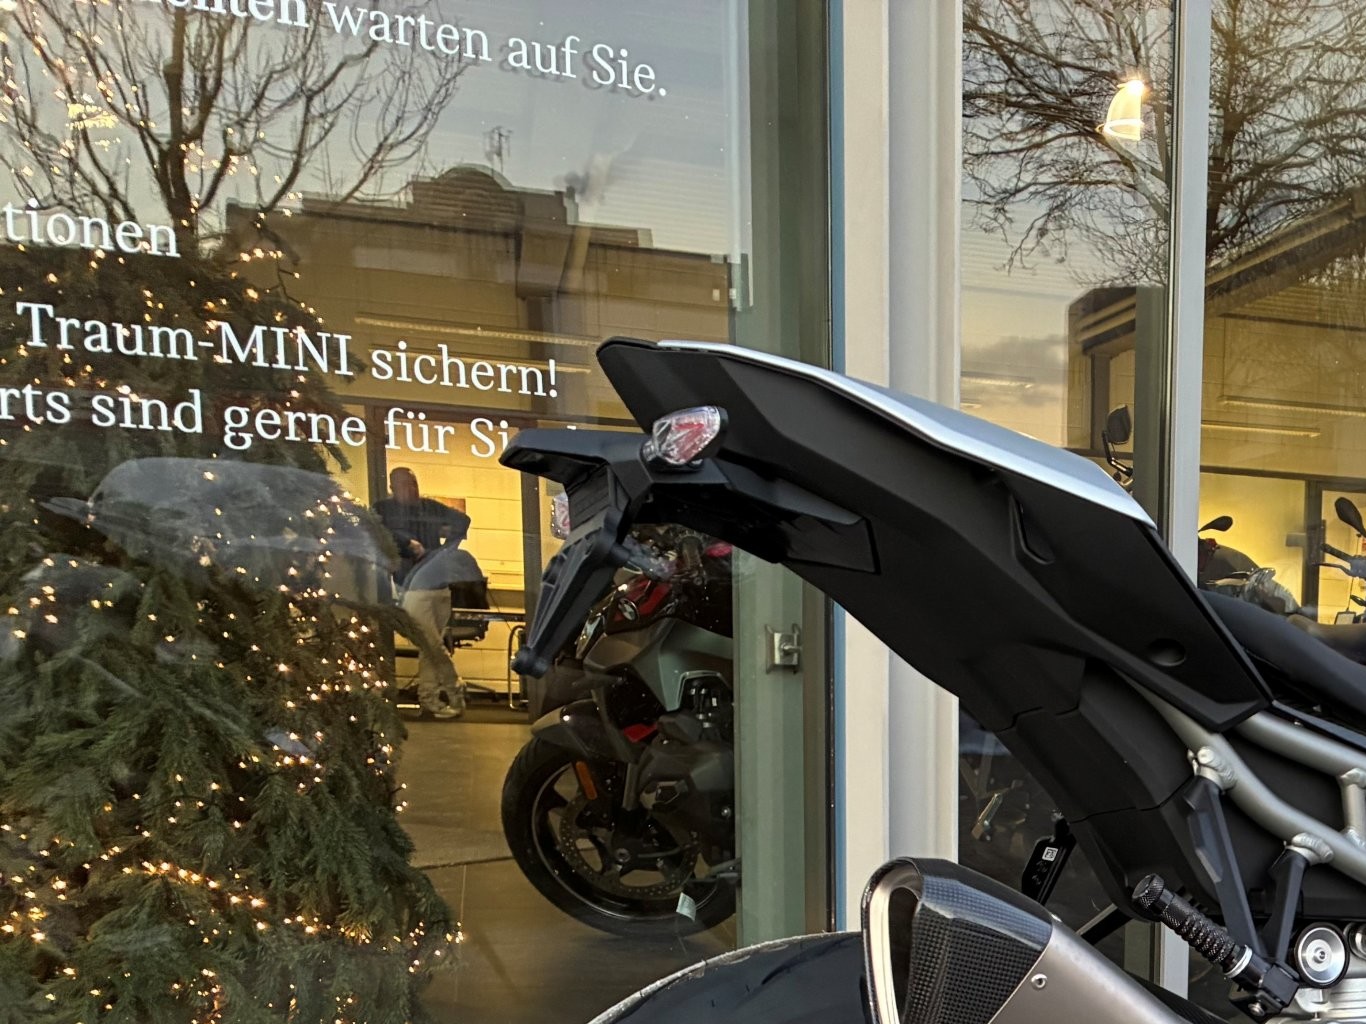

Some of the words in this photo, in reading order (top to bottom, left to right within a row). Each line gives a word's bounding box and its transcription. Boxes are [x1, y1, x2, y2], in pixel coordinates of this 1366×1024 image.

[323, 1, 492, 62] warten
[507, 35, 581, 79] auf
[591, 43, 667, 97] Sie.
[2, 201, 182, 258] tionen
[16, 301, 354, 377] Traum-MINI
[371, 340, 558, 399] sichern!
[91, 384, 203, 434] sind
[223, 404, 367, 451] gerne
[384, 407, 455, 454] für
[470, 417, 512, 459] Si
